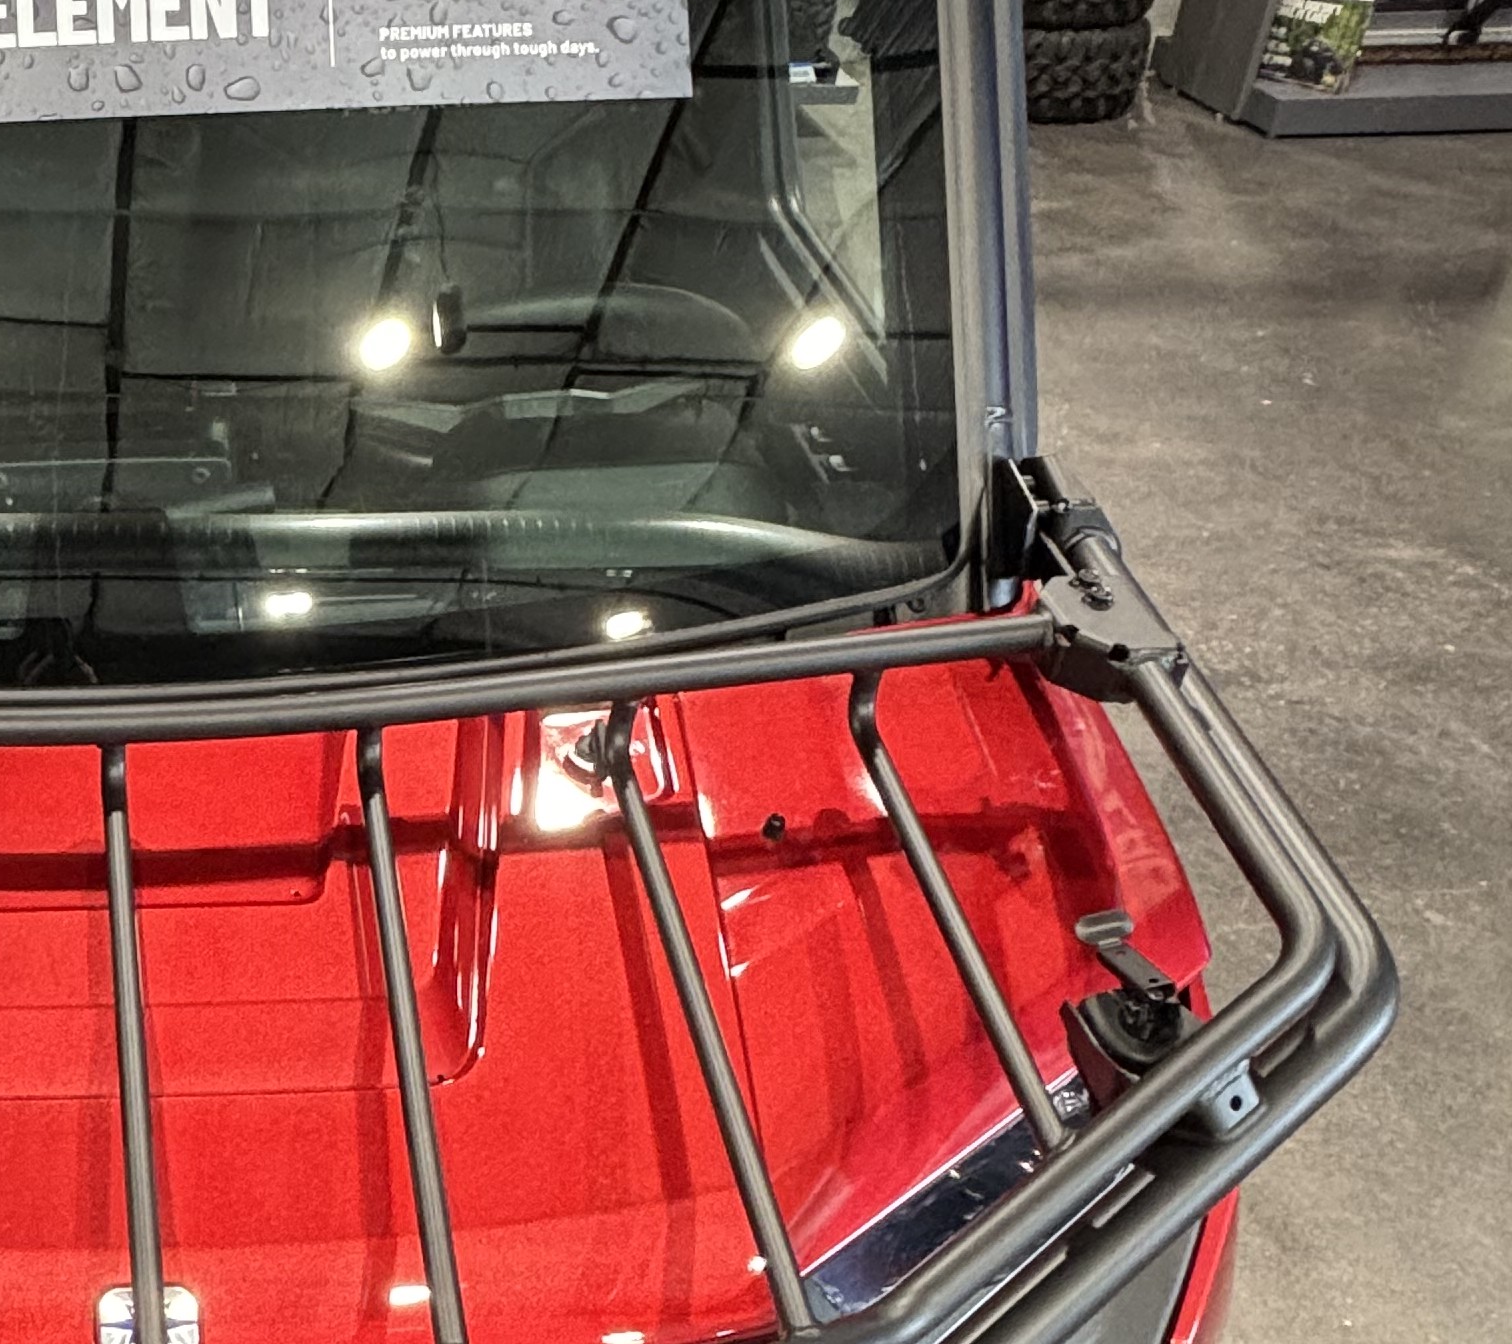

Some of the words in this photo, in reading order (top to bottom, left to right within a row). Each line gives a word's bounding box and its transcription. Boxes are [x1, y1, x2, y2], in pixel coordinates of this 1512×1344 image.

[379, 25, 450, 41] PREMIUM
[452, 22, 533, 40] FEATURES
[380, 46, 397, 60] to
[400, 45, 448, 62] power
[450, 43, 511, 60] through
[513, 40, 558, 58] tough
[560, 39, 600, 57] days.
